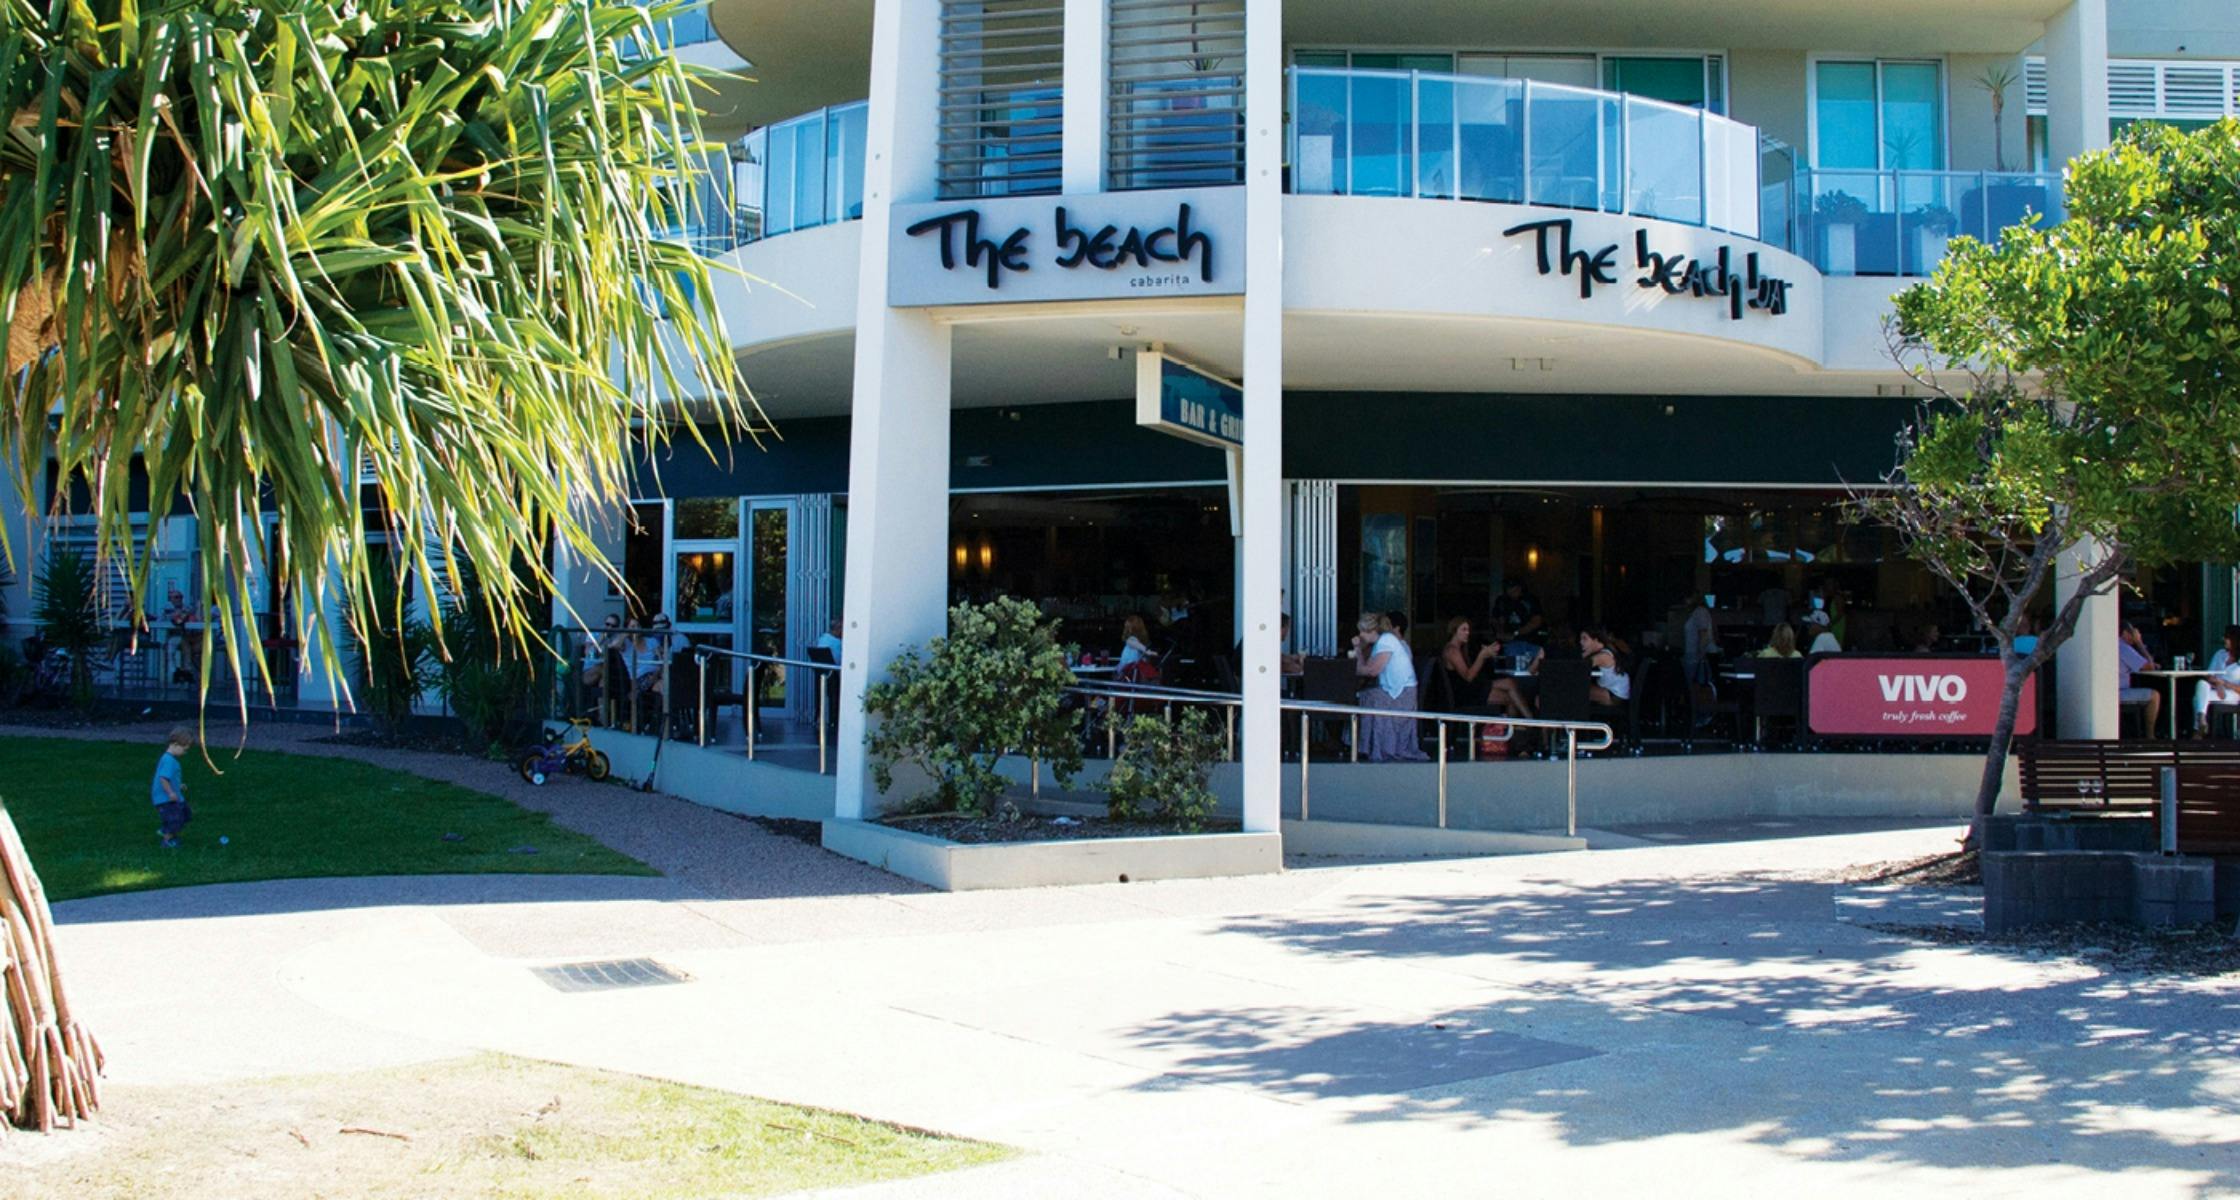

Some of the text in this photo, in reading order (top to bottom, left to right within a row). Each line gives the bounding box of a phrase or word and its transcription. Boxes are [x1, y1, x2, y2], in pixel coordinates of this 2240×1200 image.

[906, 209, 1031, 289] The
[1502, 218, 1619, 298] The
[1130, 273, 1190, 287] cabarita
[1180, 398, 1205, 429] BAR
[1209, 409, 1217, 433] &
[1878, 675, 1967, 704] VIVO
[1883, 711, 1967, 724] truly fresh coffee
